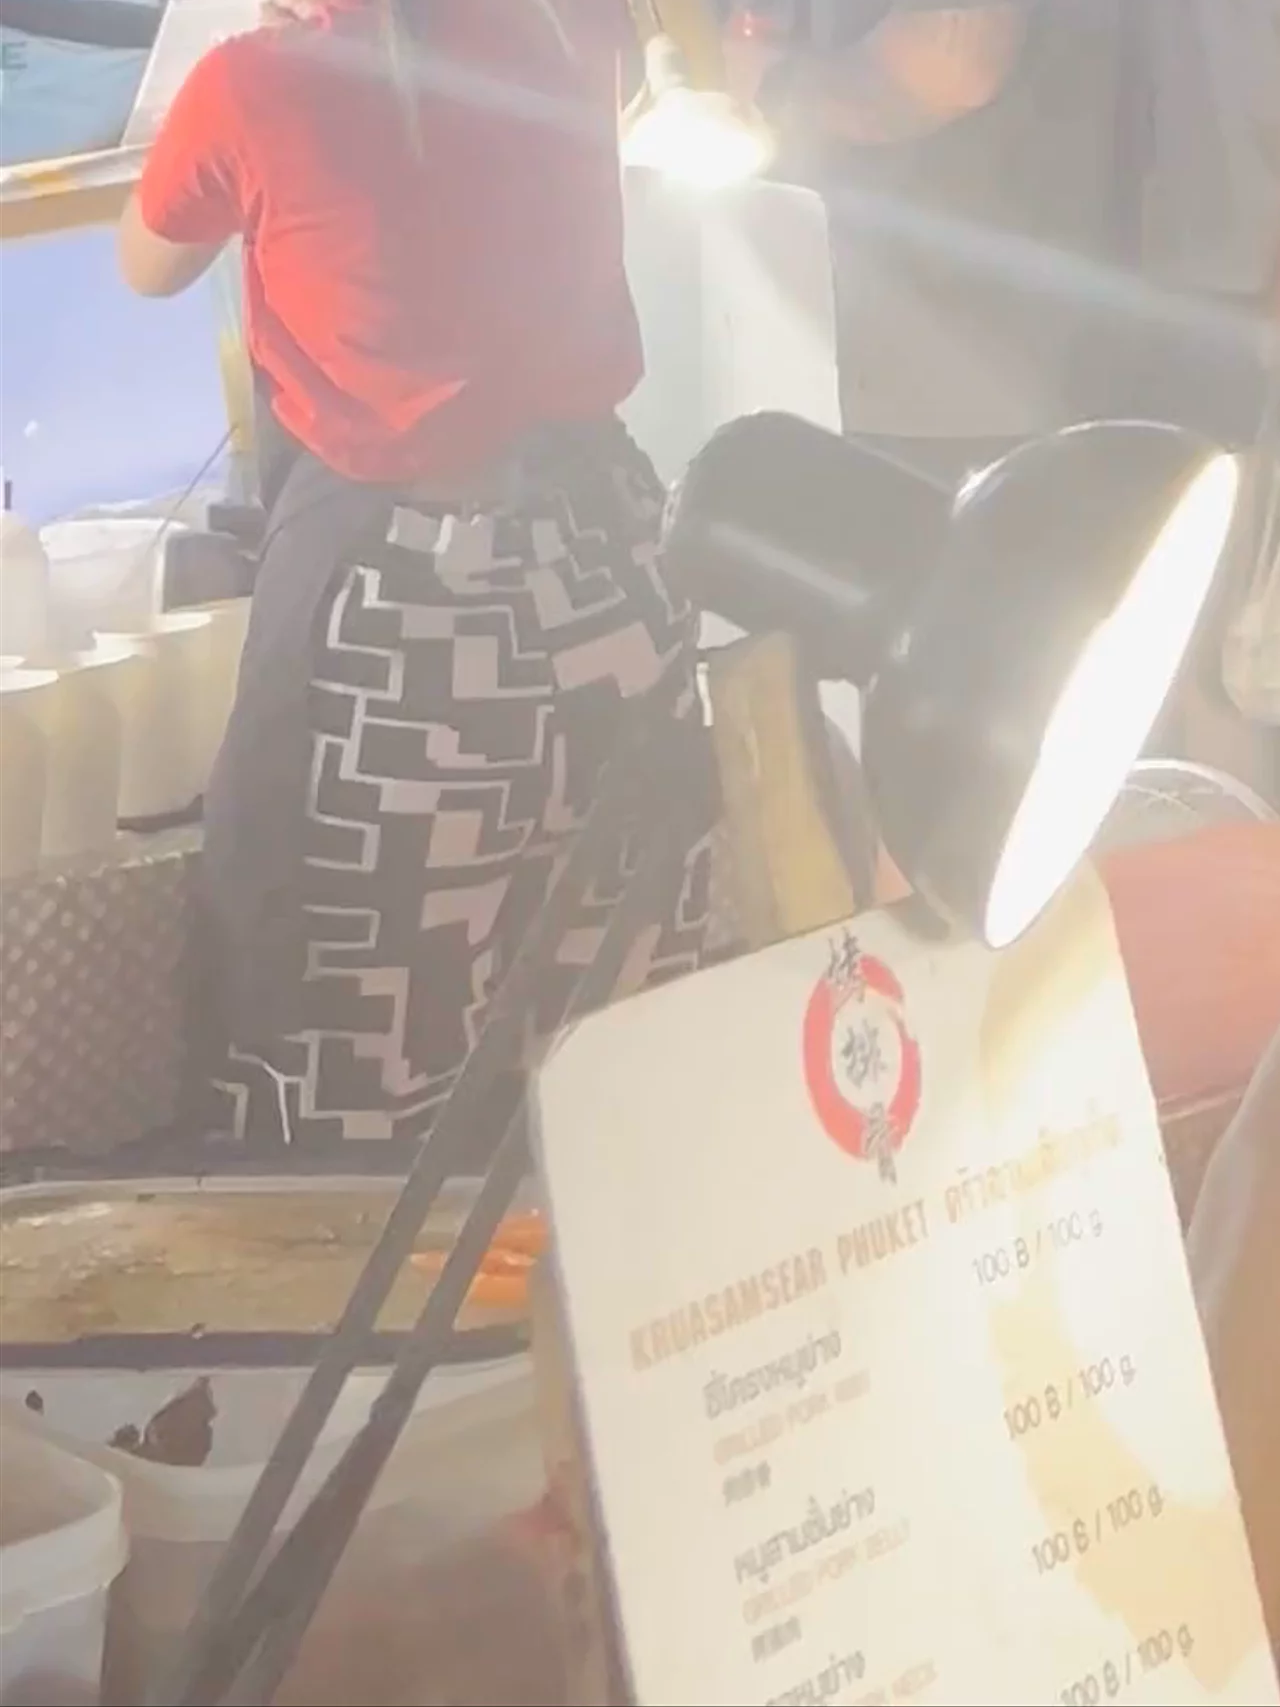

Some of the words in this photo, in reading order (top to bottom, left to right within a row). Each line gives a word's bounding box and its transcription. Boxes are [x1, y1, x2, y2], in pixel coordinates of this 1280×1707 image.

[835, 1198, 931, 1278] PHUKET
[971, 1246, 1011, 1286] 100
[1003, 1394, 1042, 1442] 100
[1079, 1356, 1116, 1400] 100
[1032, 1531, 1070, 1576] 100
[1105, 1487, 1143, 1533] 100
[1137, 1628, 1174, 1676] 100
